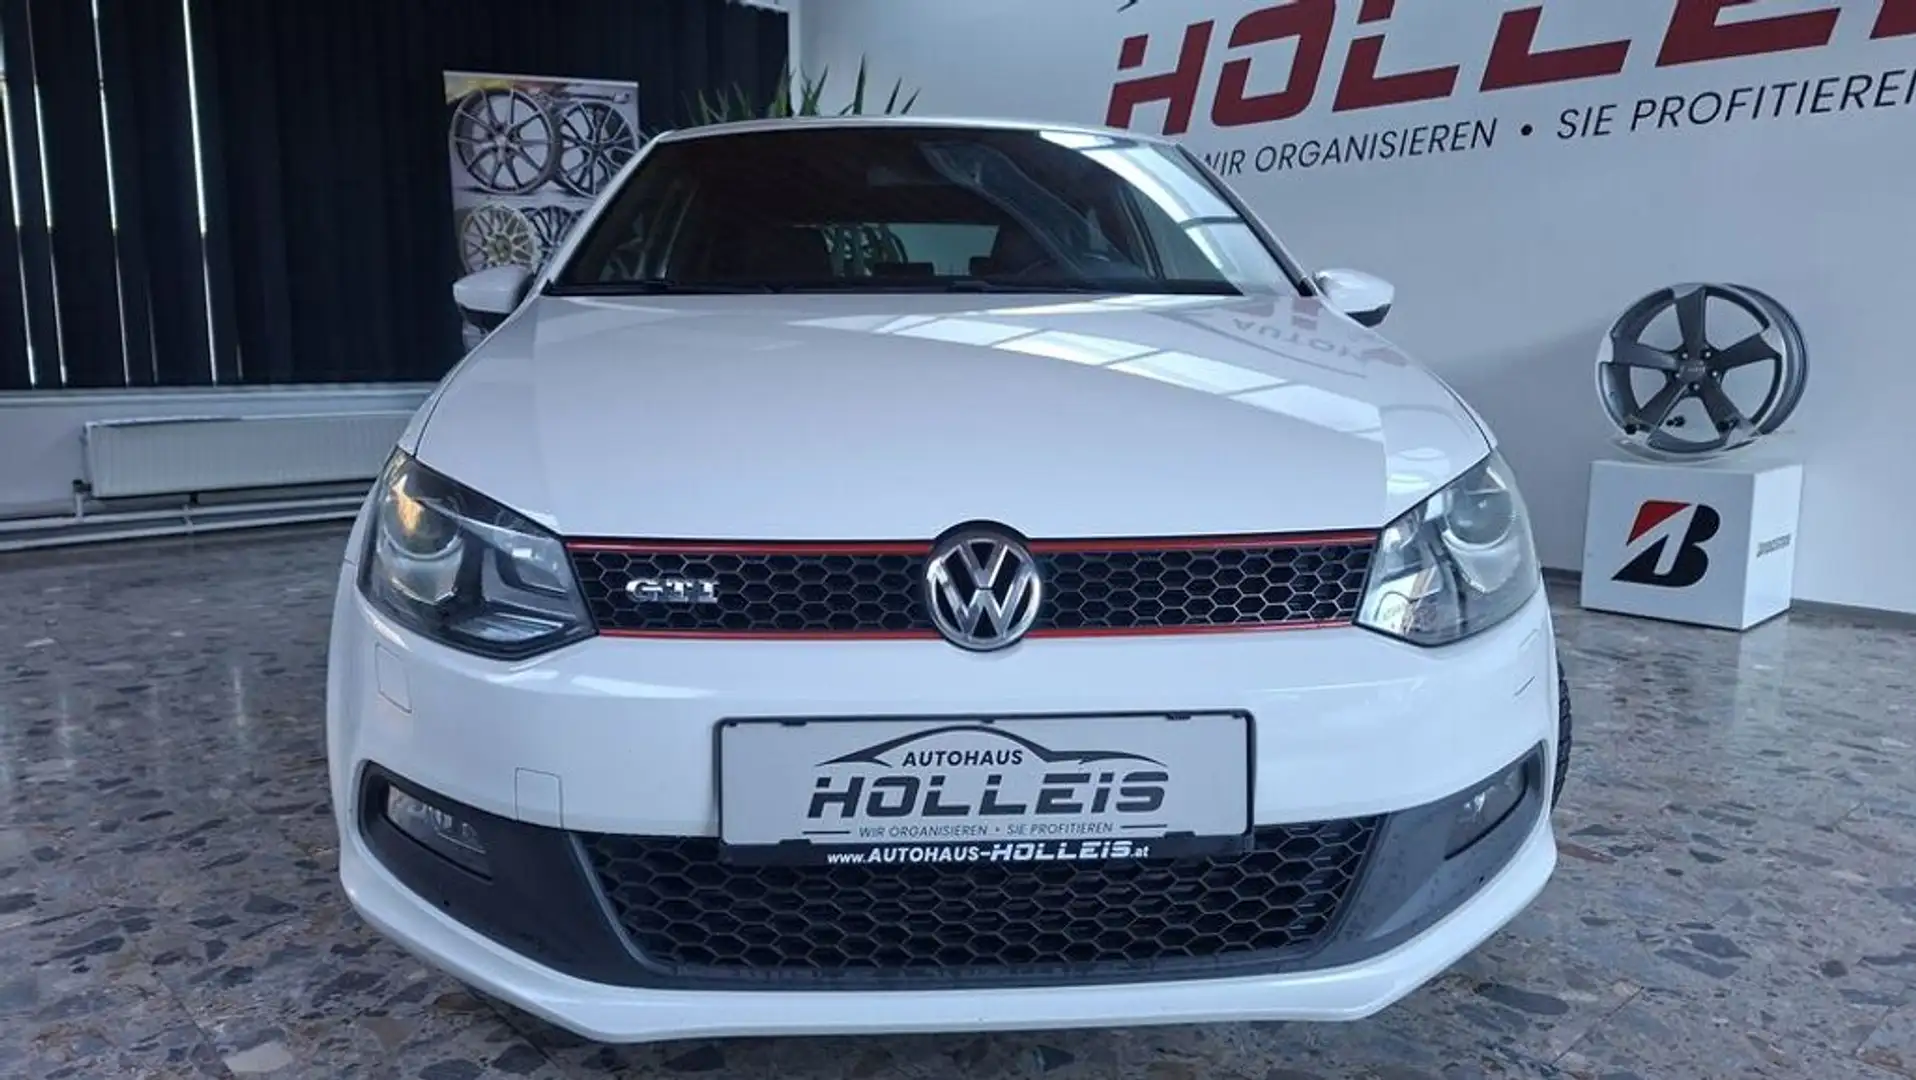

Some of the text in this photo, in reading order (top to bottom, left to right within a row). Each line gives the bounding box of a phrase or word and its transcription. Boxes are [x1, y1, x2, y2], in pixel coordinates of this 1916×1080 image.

[1254, 117, 1498, 173] ORGANISIEREN
[1556, 104, 1618, 140] SIE
[1630, 68, 1916, 132] PROFITIERE
[625, 578, 720, 603] GTI
[902, 749, 1024, 768] AUTOHAUS
[807, 771, 1169, 819] HOLLEIS
[858, 822, 1114, 839] WIR ORGANISIEREN SIE PROFITIEREN
